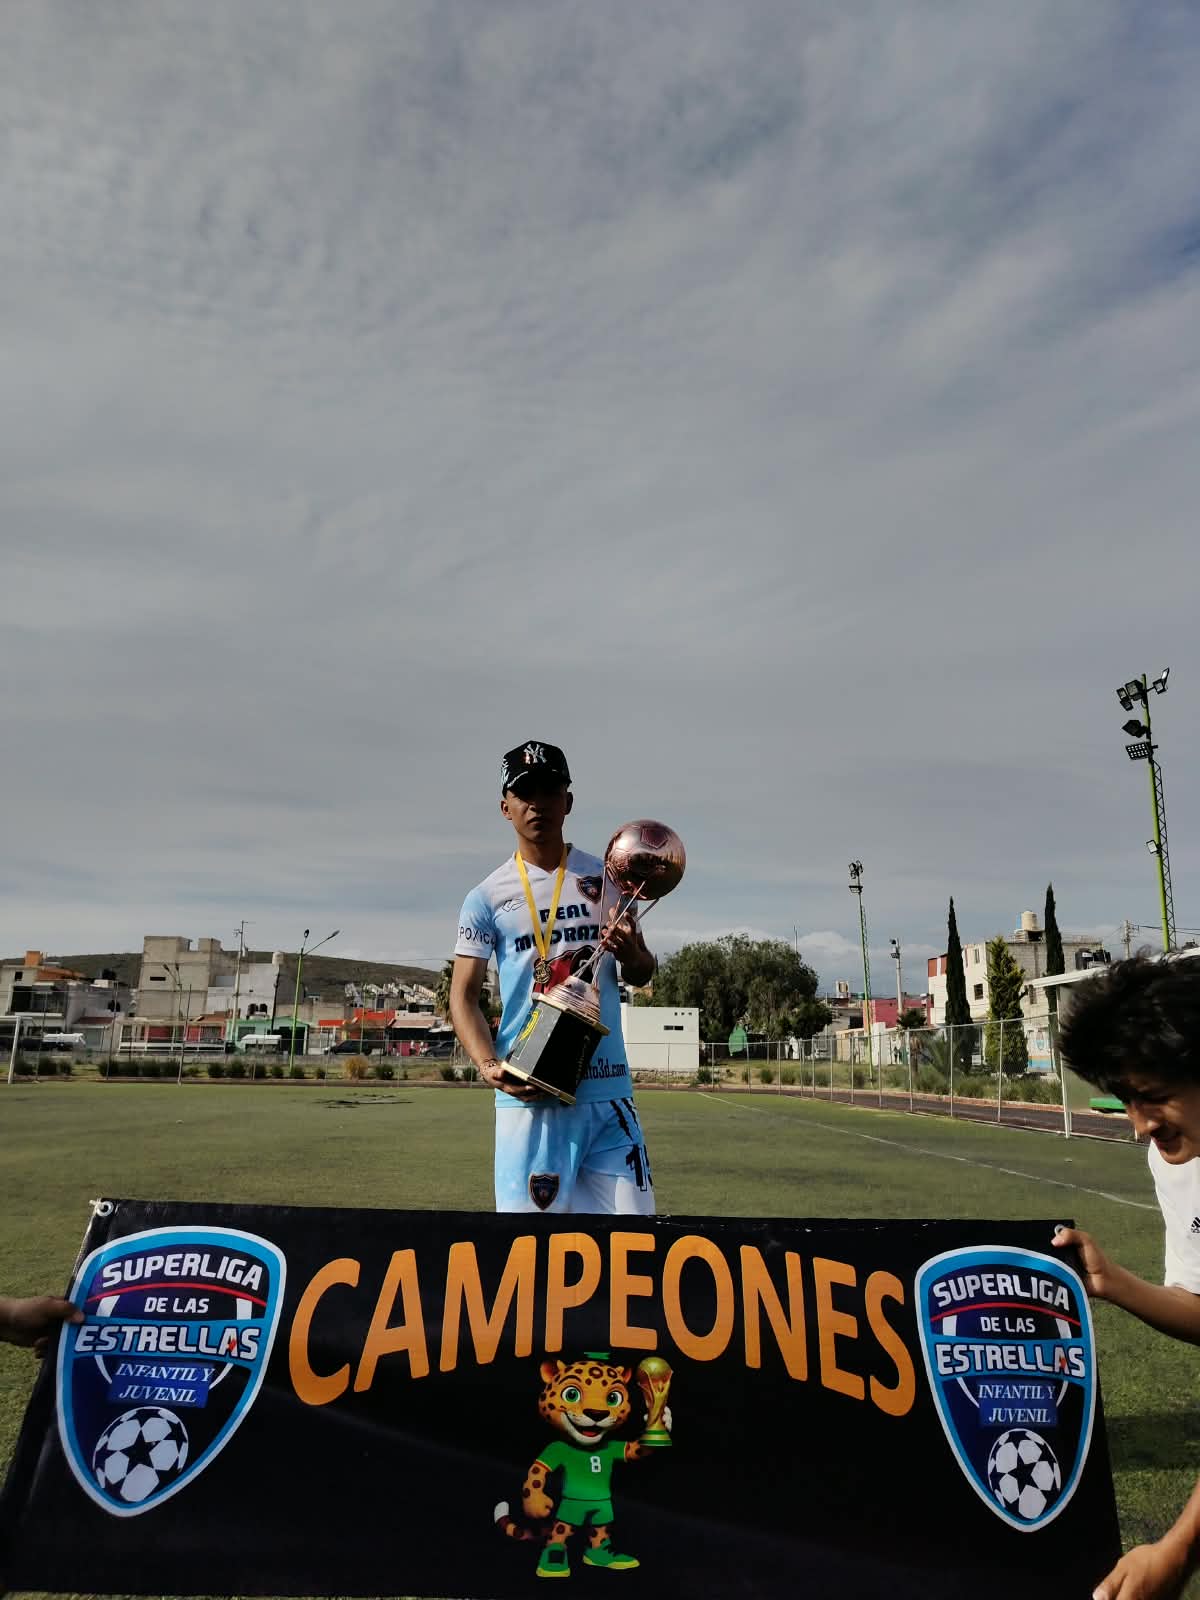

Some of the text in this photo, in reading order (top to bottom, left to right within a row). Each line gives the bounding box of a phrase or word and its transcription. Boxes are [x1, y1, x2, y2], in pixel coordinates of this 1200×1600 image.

[523, 743, 547, 764] NY
[102, 1253, 263, 1291] SUPERLIGA
[933, 1273, 1069, 1311] SUPERLIGA
[144, 1297, 210, 1314] DE LAS
[289, 1231, 916, 1417] CAMPEONES
[980, 1316, 1036, 1334] DE LAS
[74, 1325, 261, 1360] ESTRELLAS
[935, 1344, 1086, 1378] ESTRELLAS
[115, 1363, 216, 1383] INFANTIL Y
[119, 1384, 198, 1404] JUVENIL
[978, 1384, 1057, 1401] INFANTIL Y
[989, 1407, 1051, 1424] JUVENIL
[590, 1455, 602, 1473] 8
